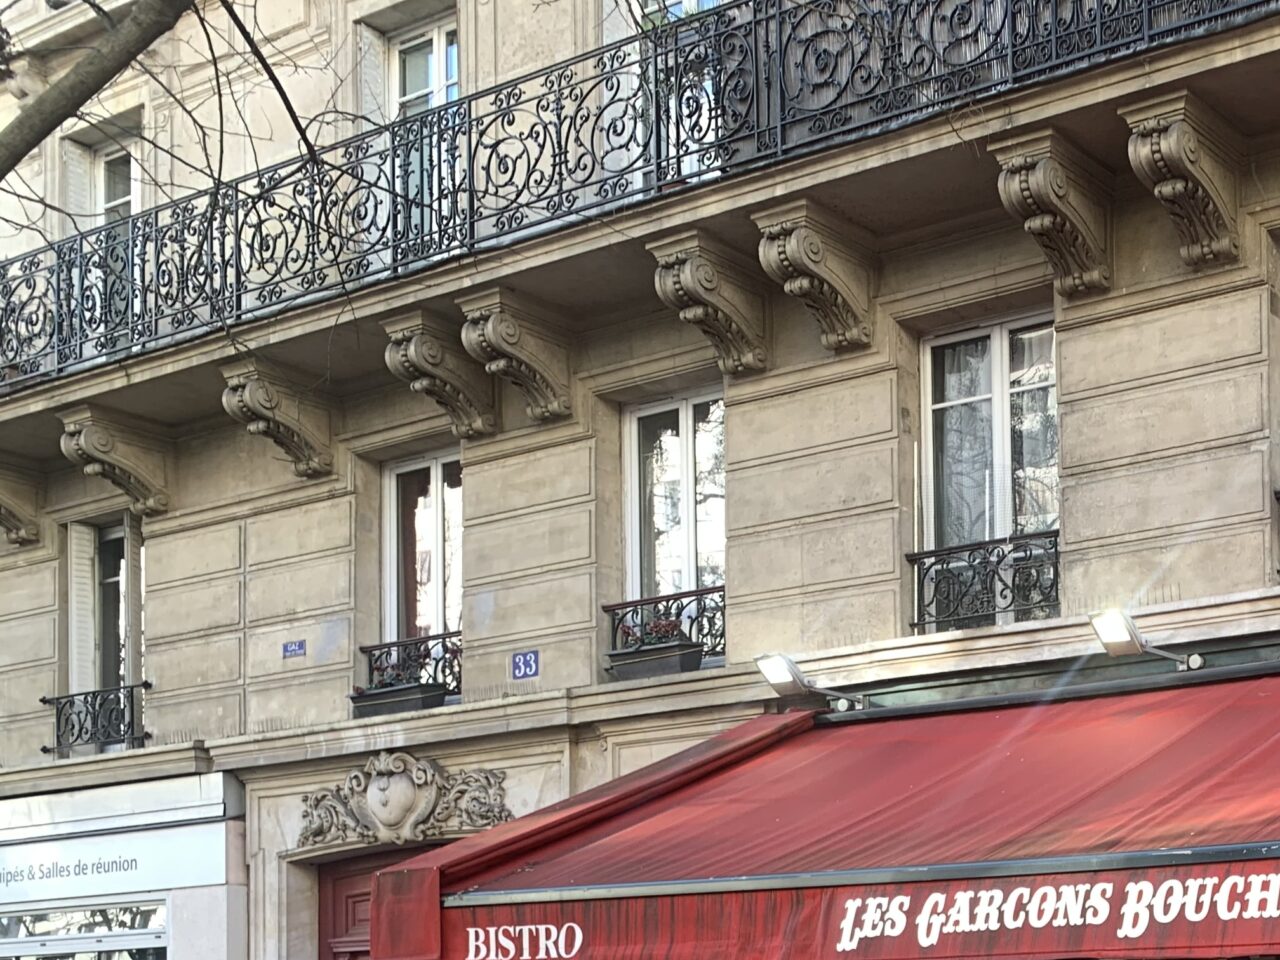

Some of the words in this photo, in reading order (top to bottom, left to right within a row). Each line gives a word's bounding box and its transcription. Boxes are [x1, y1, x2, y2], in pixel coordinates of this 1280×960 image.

[515, 653, 537, 677] 33
[0, 866, 25, 887] ipés
[27, 864, 36, 880] &
[38, 861, 71, 880] Salles
[73, 859, 89, 877] de
[91, 856, 138, 875] réunion
[836, 895, 911, 952] LES
[915, 882, 1114, 948] GARCONS
[465, 922, 583, 960] BISTRO
